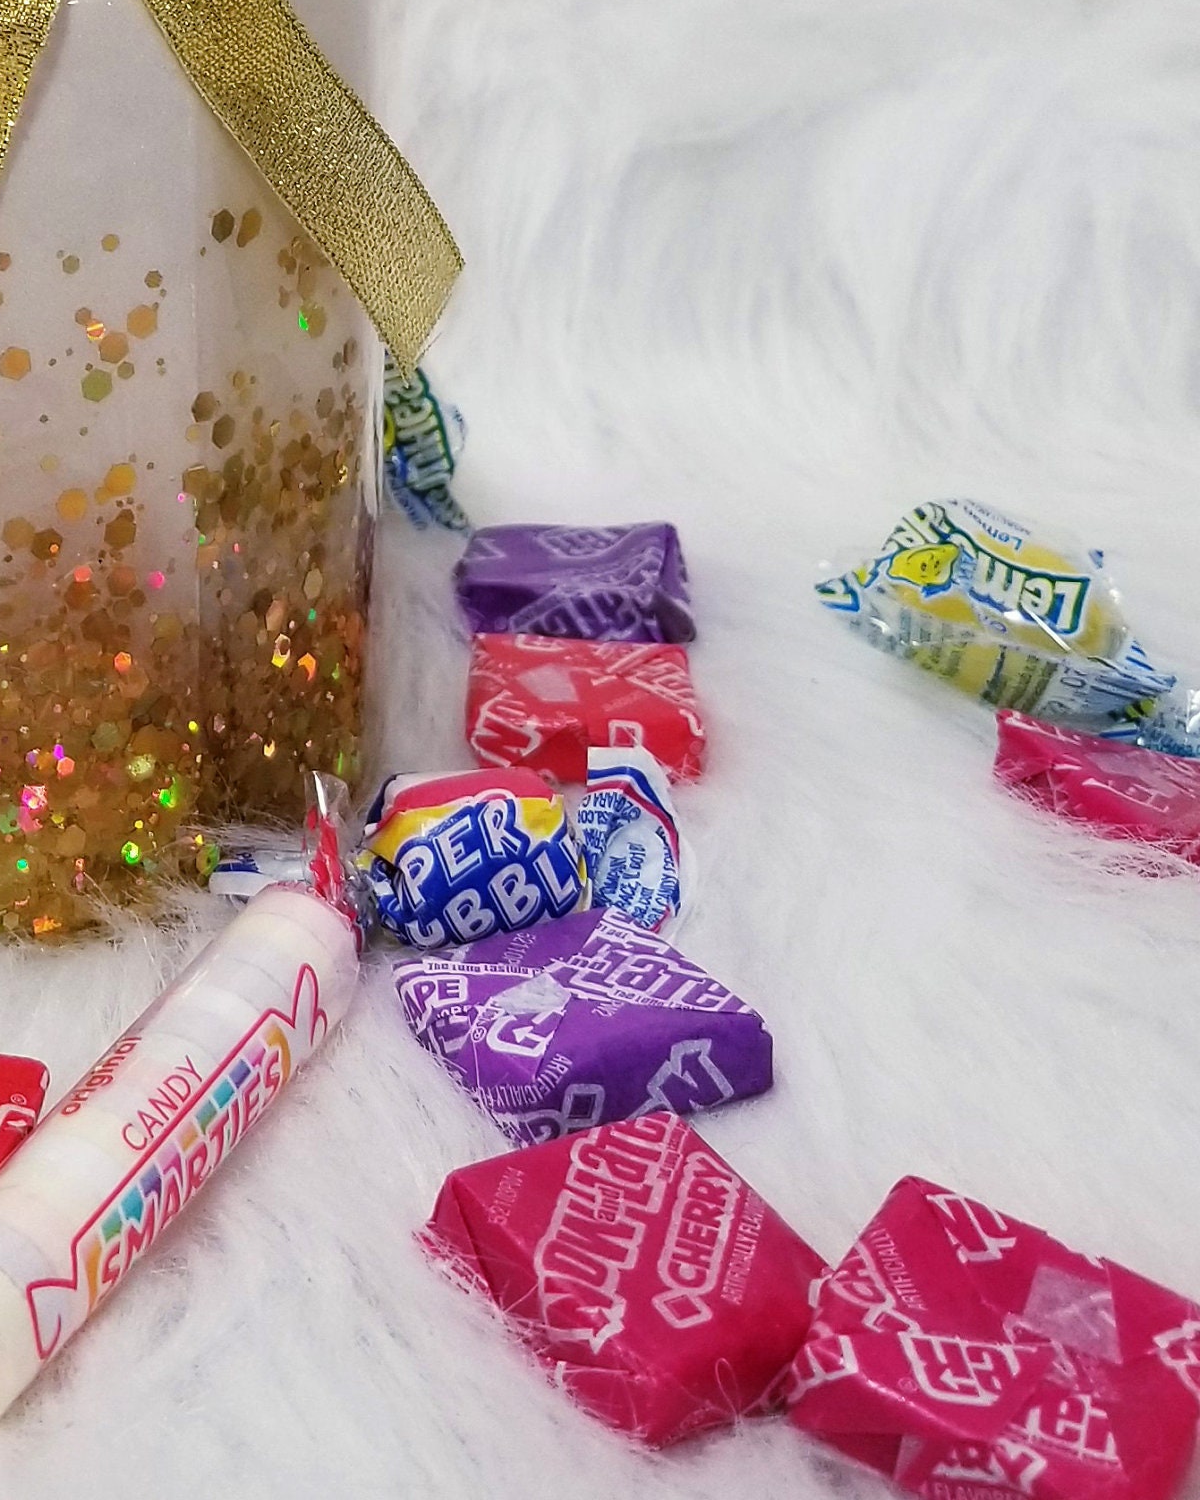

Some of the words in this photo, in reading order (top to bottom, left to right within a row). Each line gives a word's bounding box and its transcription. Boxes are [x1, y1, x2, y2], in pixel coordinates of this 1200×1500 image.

[61, 1035, 142, 1116] original
[121, 1054, 203, 1152] CANDY
[101, 1049, 282, 1287] SMARTIES
[661, 1157, 742, 1292] CHERRY
